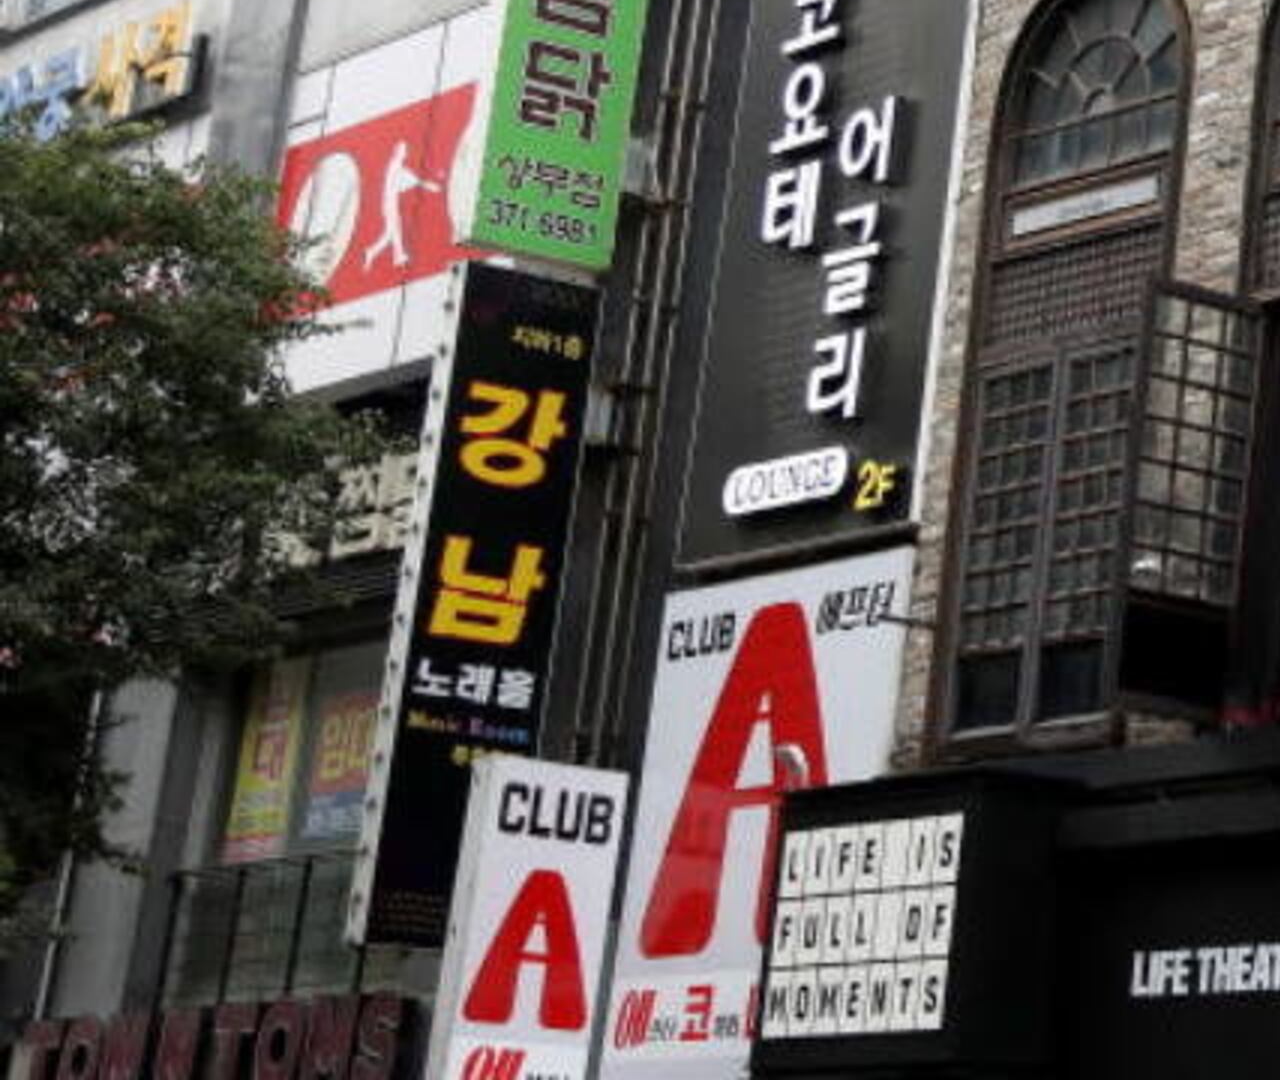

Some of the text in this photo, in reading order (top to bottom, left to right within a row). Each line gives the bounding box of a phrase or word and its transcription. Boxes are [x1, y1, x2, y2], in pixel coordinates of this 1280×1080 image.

[805, 93, 896, 419] 어글리
[733, 455, 896, 511] LOUNGE 2F
[427, 379, 567, 646] 강남
[667, 610, 736, 661] CLUB
[639, 601, 830, 959] A
[498, 782, 615, 845] CLUB
[788, 830, 956, 883] LIFE IS
[462, 868, 586, 1031] A
[777, 904, 949, 951] FULL OF
[769, 975, 940, 1020] MOMENTS
[1131, 948, 1192, 997] LIFE
